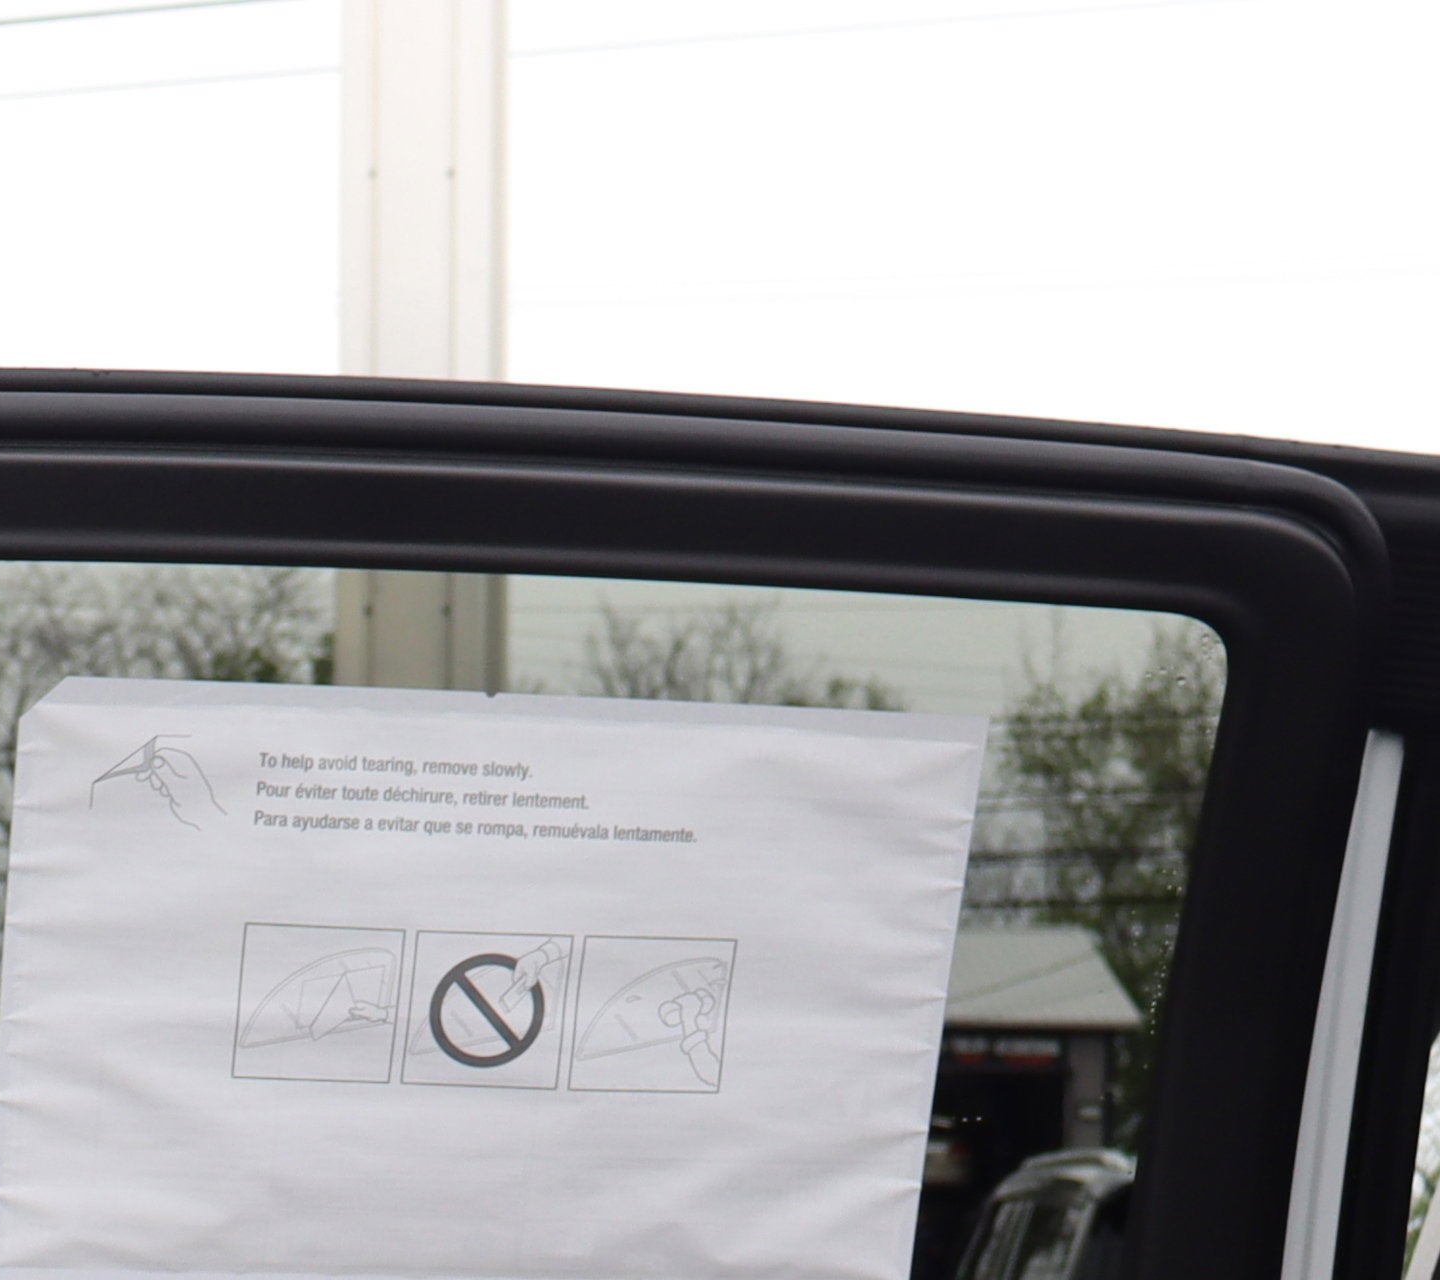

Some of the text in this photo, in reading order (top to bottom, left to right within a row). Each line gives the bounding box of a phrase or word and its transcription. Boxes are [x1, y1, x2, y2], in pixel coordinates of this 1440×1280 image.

[258, 752, 533, 781] To help avoid tearing, remove slowly.
[256, 781, 589, 809] Pour éviter toute déchirure, retirer lentement.
[253, 811, 697, 843] Para ayudarse a evitar que se rompa, remuévala lentamente.
